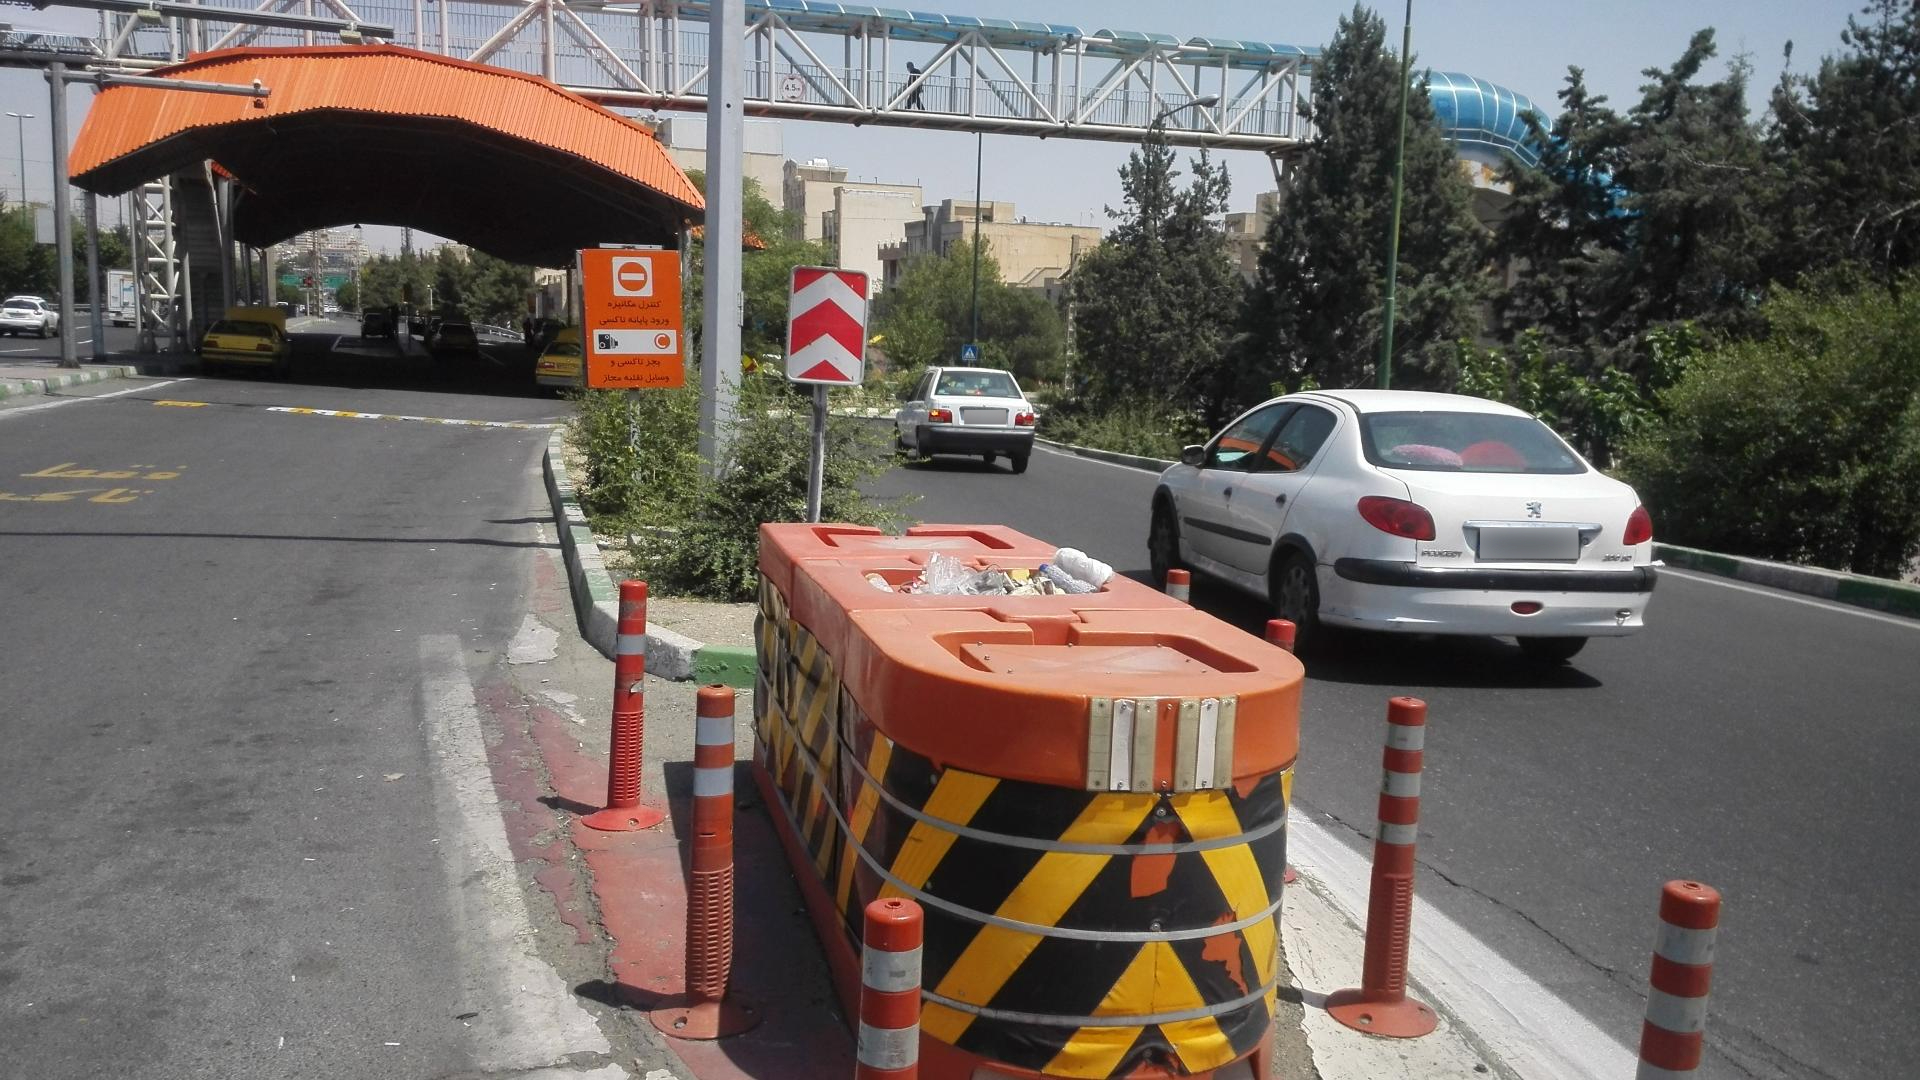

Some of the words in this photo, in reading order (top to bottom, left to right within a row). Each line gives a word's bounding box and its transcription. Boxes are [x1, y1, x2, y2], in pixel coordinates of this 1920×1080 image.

[607, 300, 637, 309] مکانیزه
[638, 300, 662, 309] کنترل
[599, 316, 626, 326] تاکسی
[628, 316, 649, 326] پایانه
[650, 317, 670, 325] ورود
[617, 358, 643, 367] تاکسی
[645, 359, 661, 367] بجز
[603, 374, 621, 383] مجاز
[645, 374, 670, 383] وسایل
[19, 462, 188, 480] فقط
[1421, 550, 1463, 559] PEUGEOT
